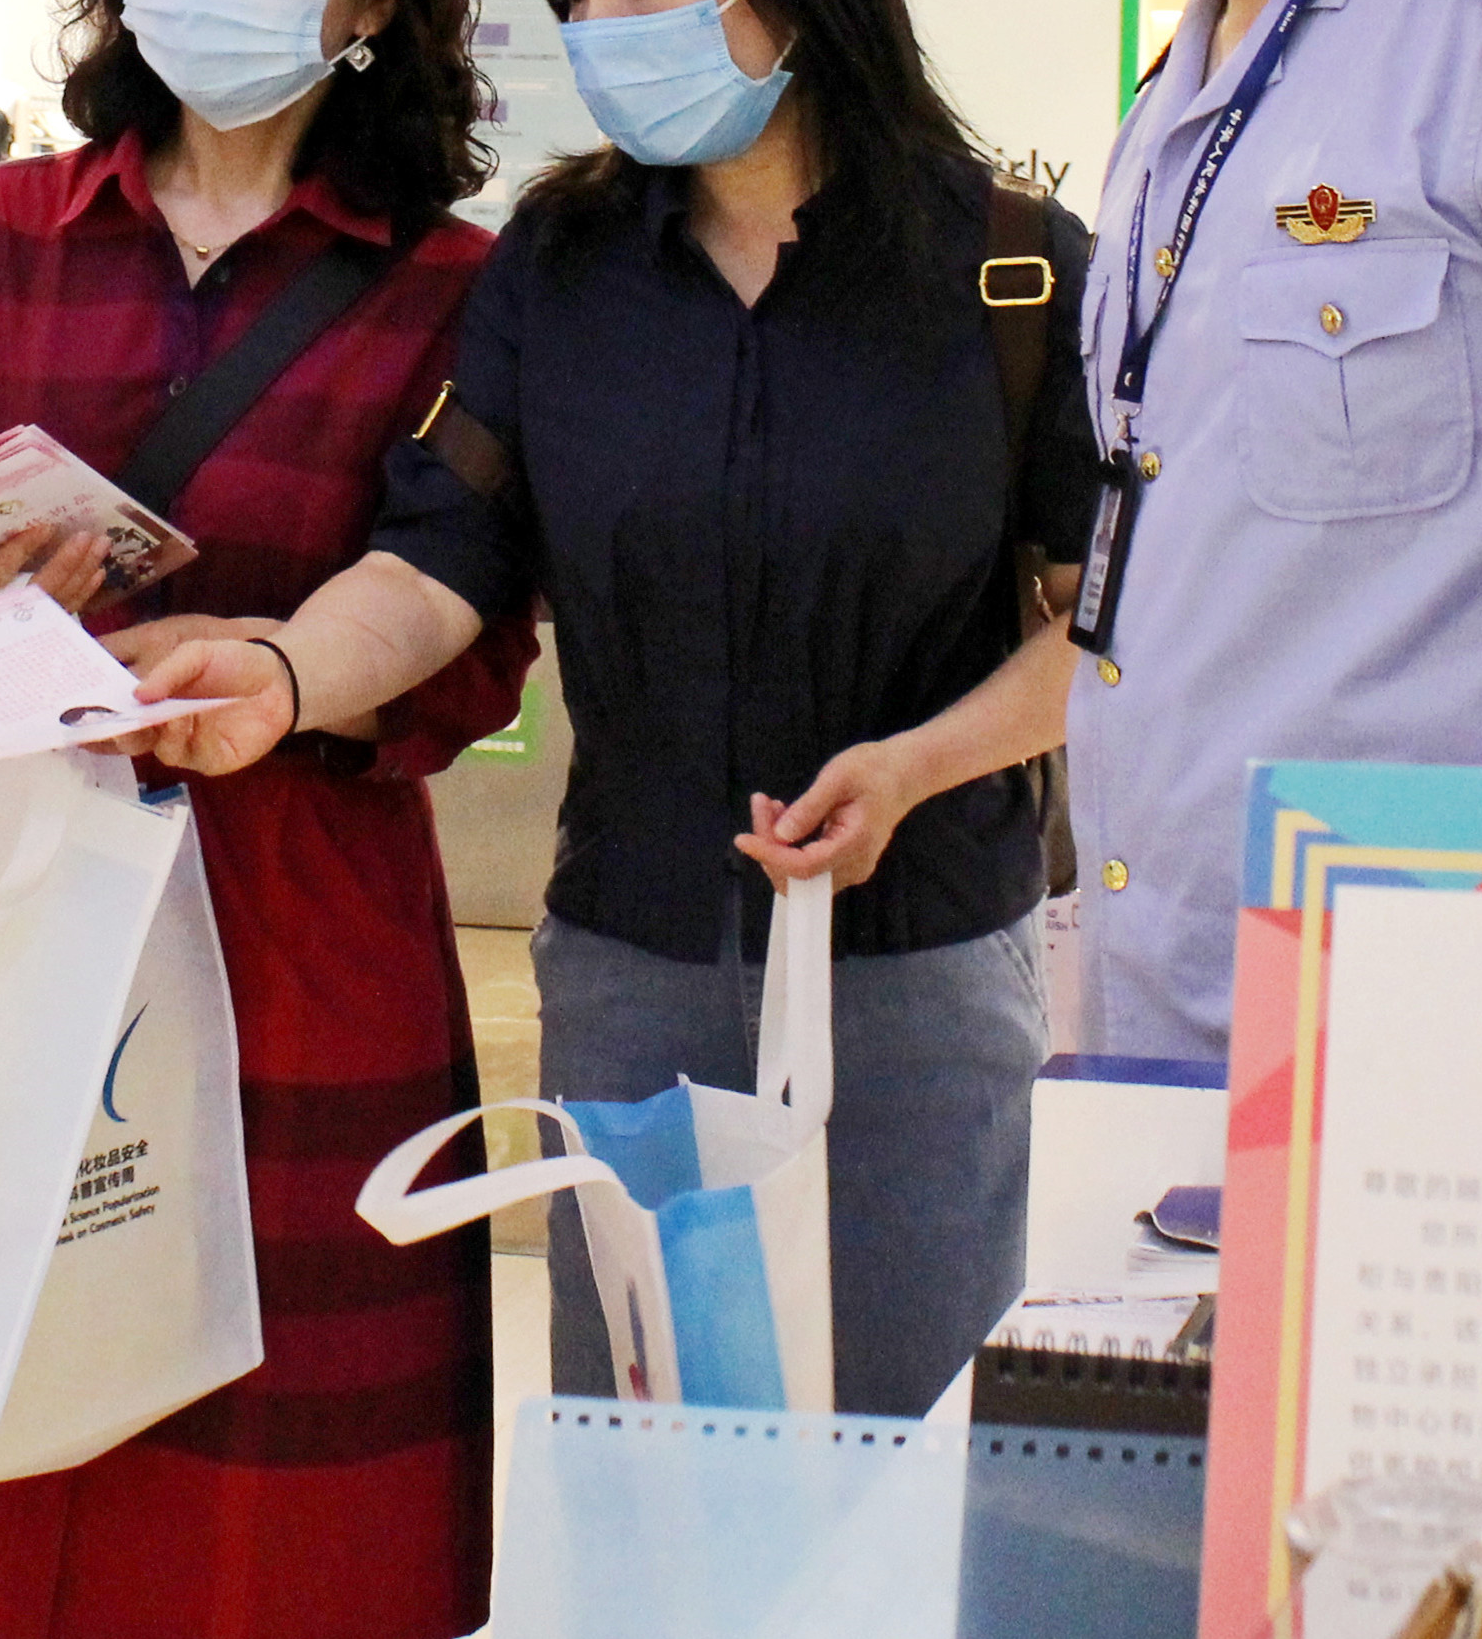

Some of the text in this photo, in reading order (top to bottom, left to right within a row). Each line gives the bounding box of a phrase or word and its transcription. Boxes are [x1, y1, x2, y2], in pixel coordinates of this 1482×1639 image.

[77, 1139, 148, 1178] 化妆品安全
[58, 1231, 74, 1244] eek
